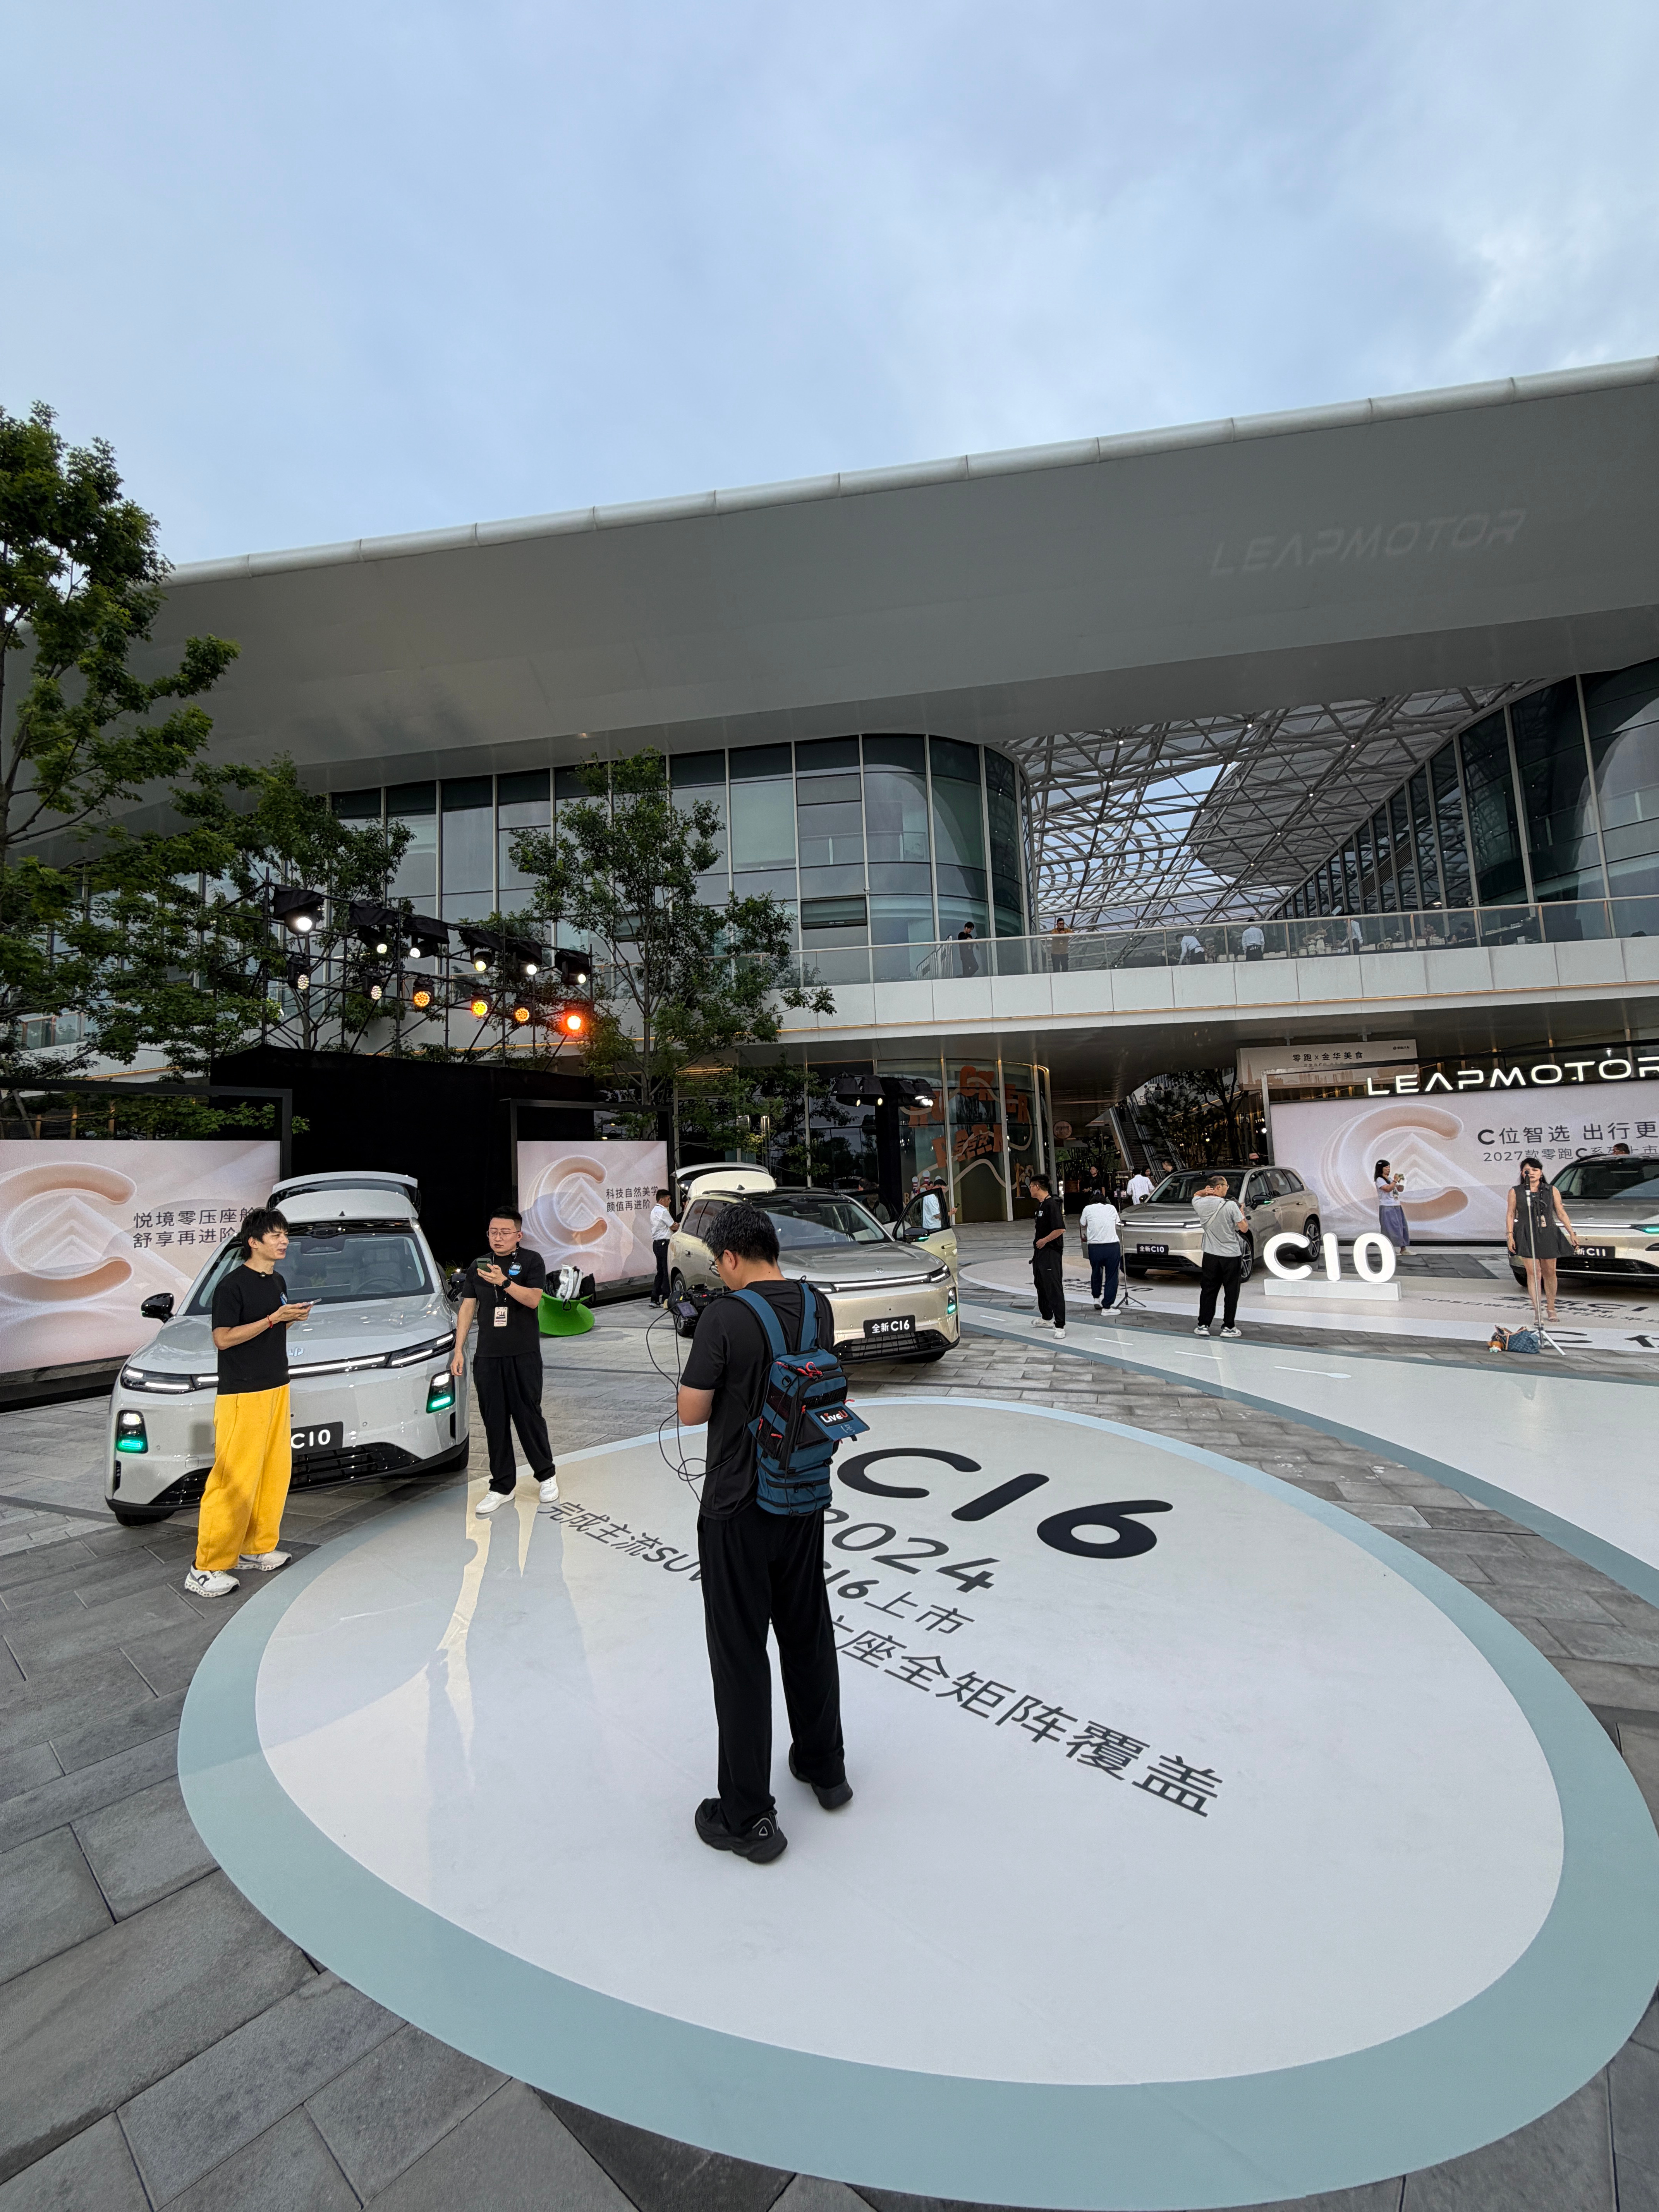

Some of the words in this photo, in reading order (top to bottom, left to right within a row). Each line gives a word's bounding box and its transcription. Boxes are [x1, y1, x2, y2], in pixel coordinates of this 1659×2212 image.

[1211, 509, 1526, 575] LEAPMOTOR
[606, 1185, 658, 1199] 科技自然美学
[606, 1199, 651, 1212] 颜值再进阶
[1263, 1232, 1396, 1283] C10
[872, 1319, 910, 1333] 全新C16
[837, 1448, 1173, 1559] C16
